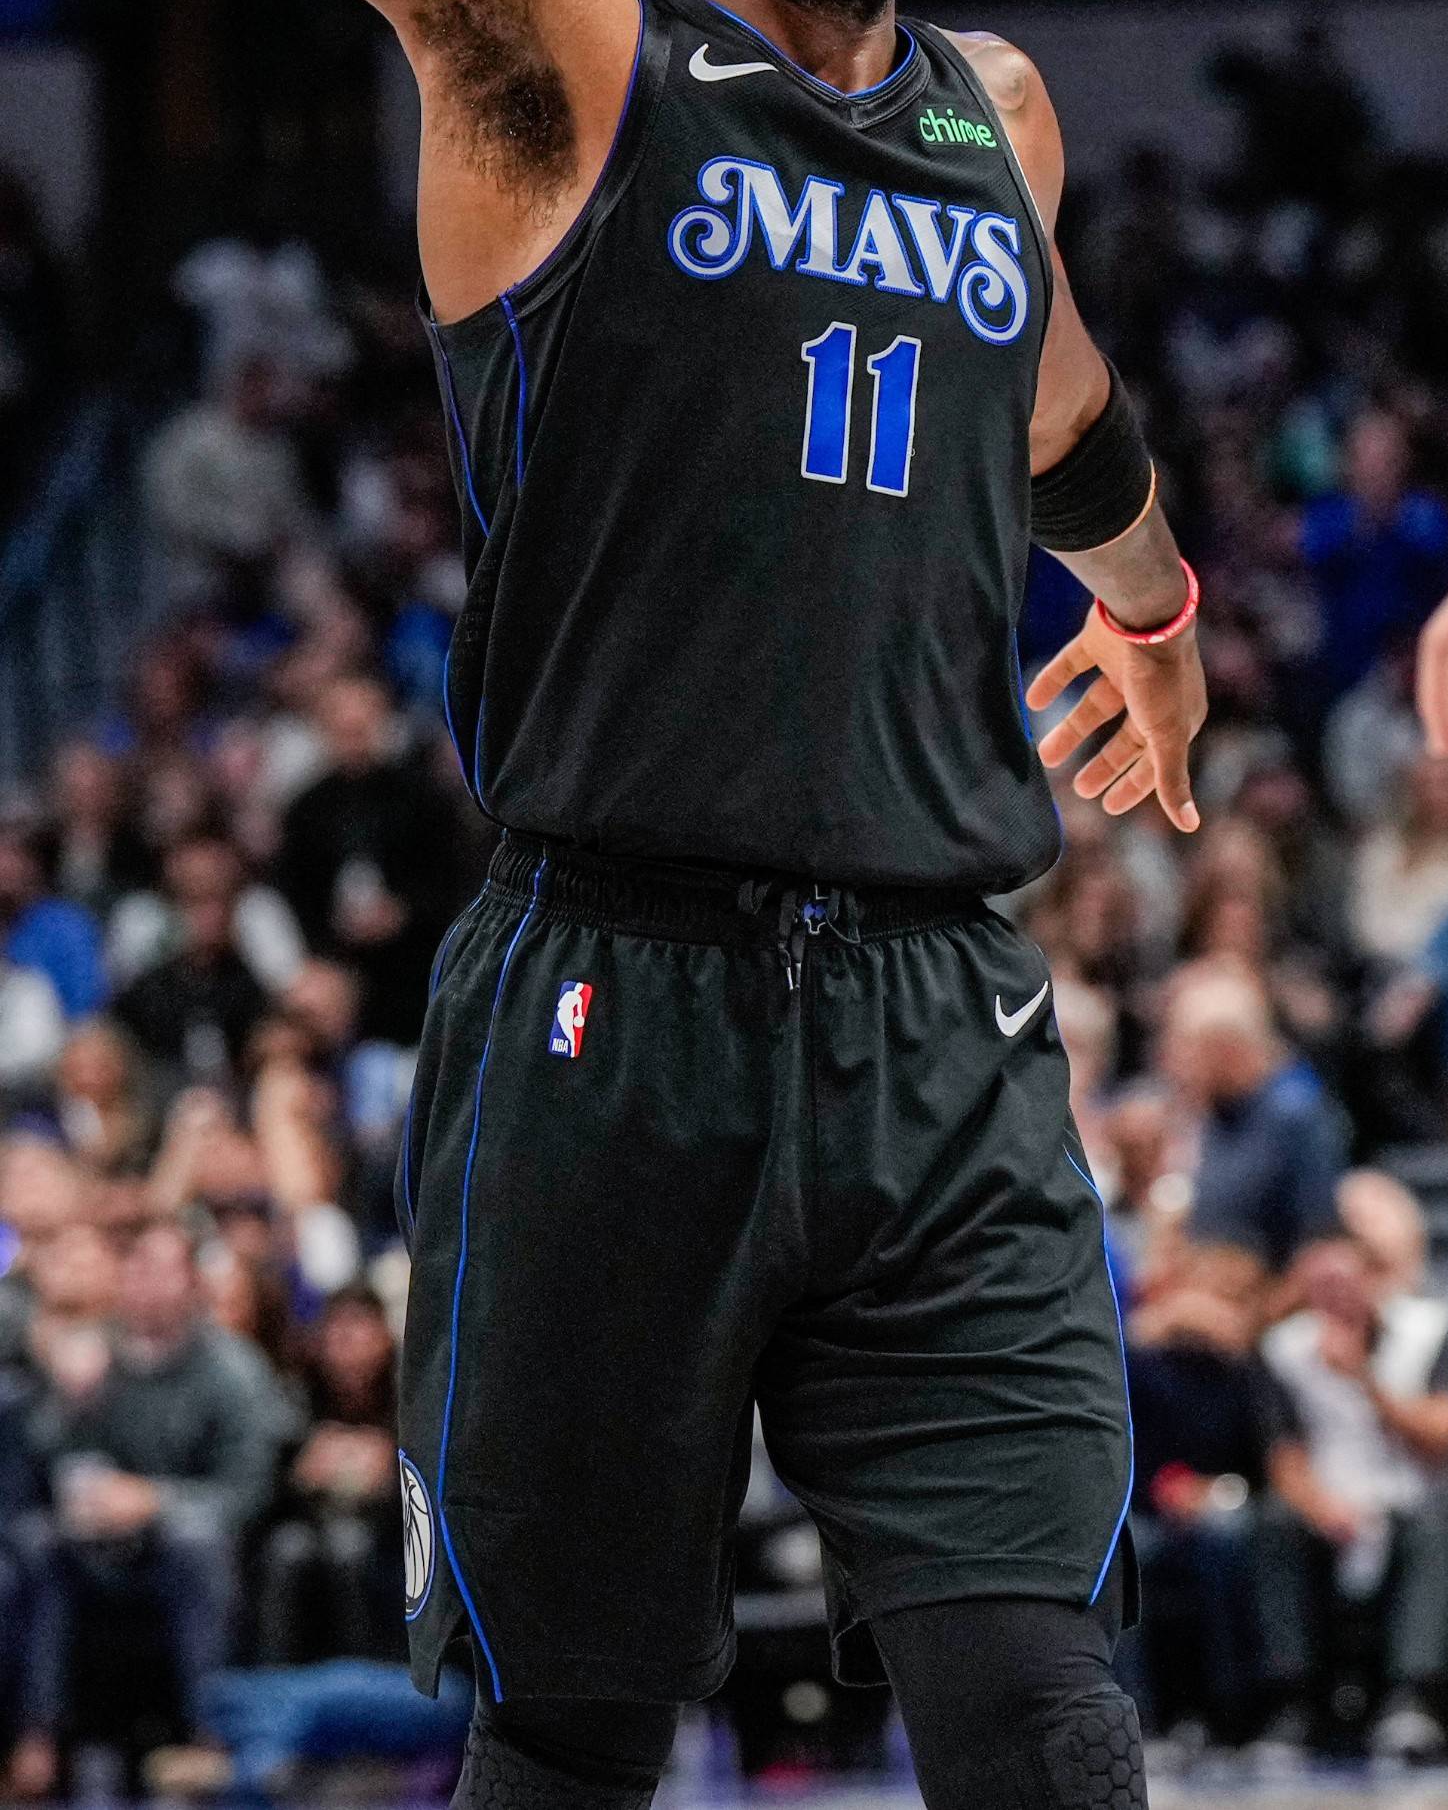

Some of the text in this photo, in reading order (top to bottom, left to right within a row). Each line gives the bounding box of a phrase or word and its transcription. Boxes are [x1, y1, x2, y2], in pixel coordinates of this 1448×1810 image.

[919, 108, 998, 148] chime
[668, 155, 1030, 345] MAVS
[801, 321, 922, 498] 11
[551, 1037, 569, 1054] NBA
